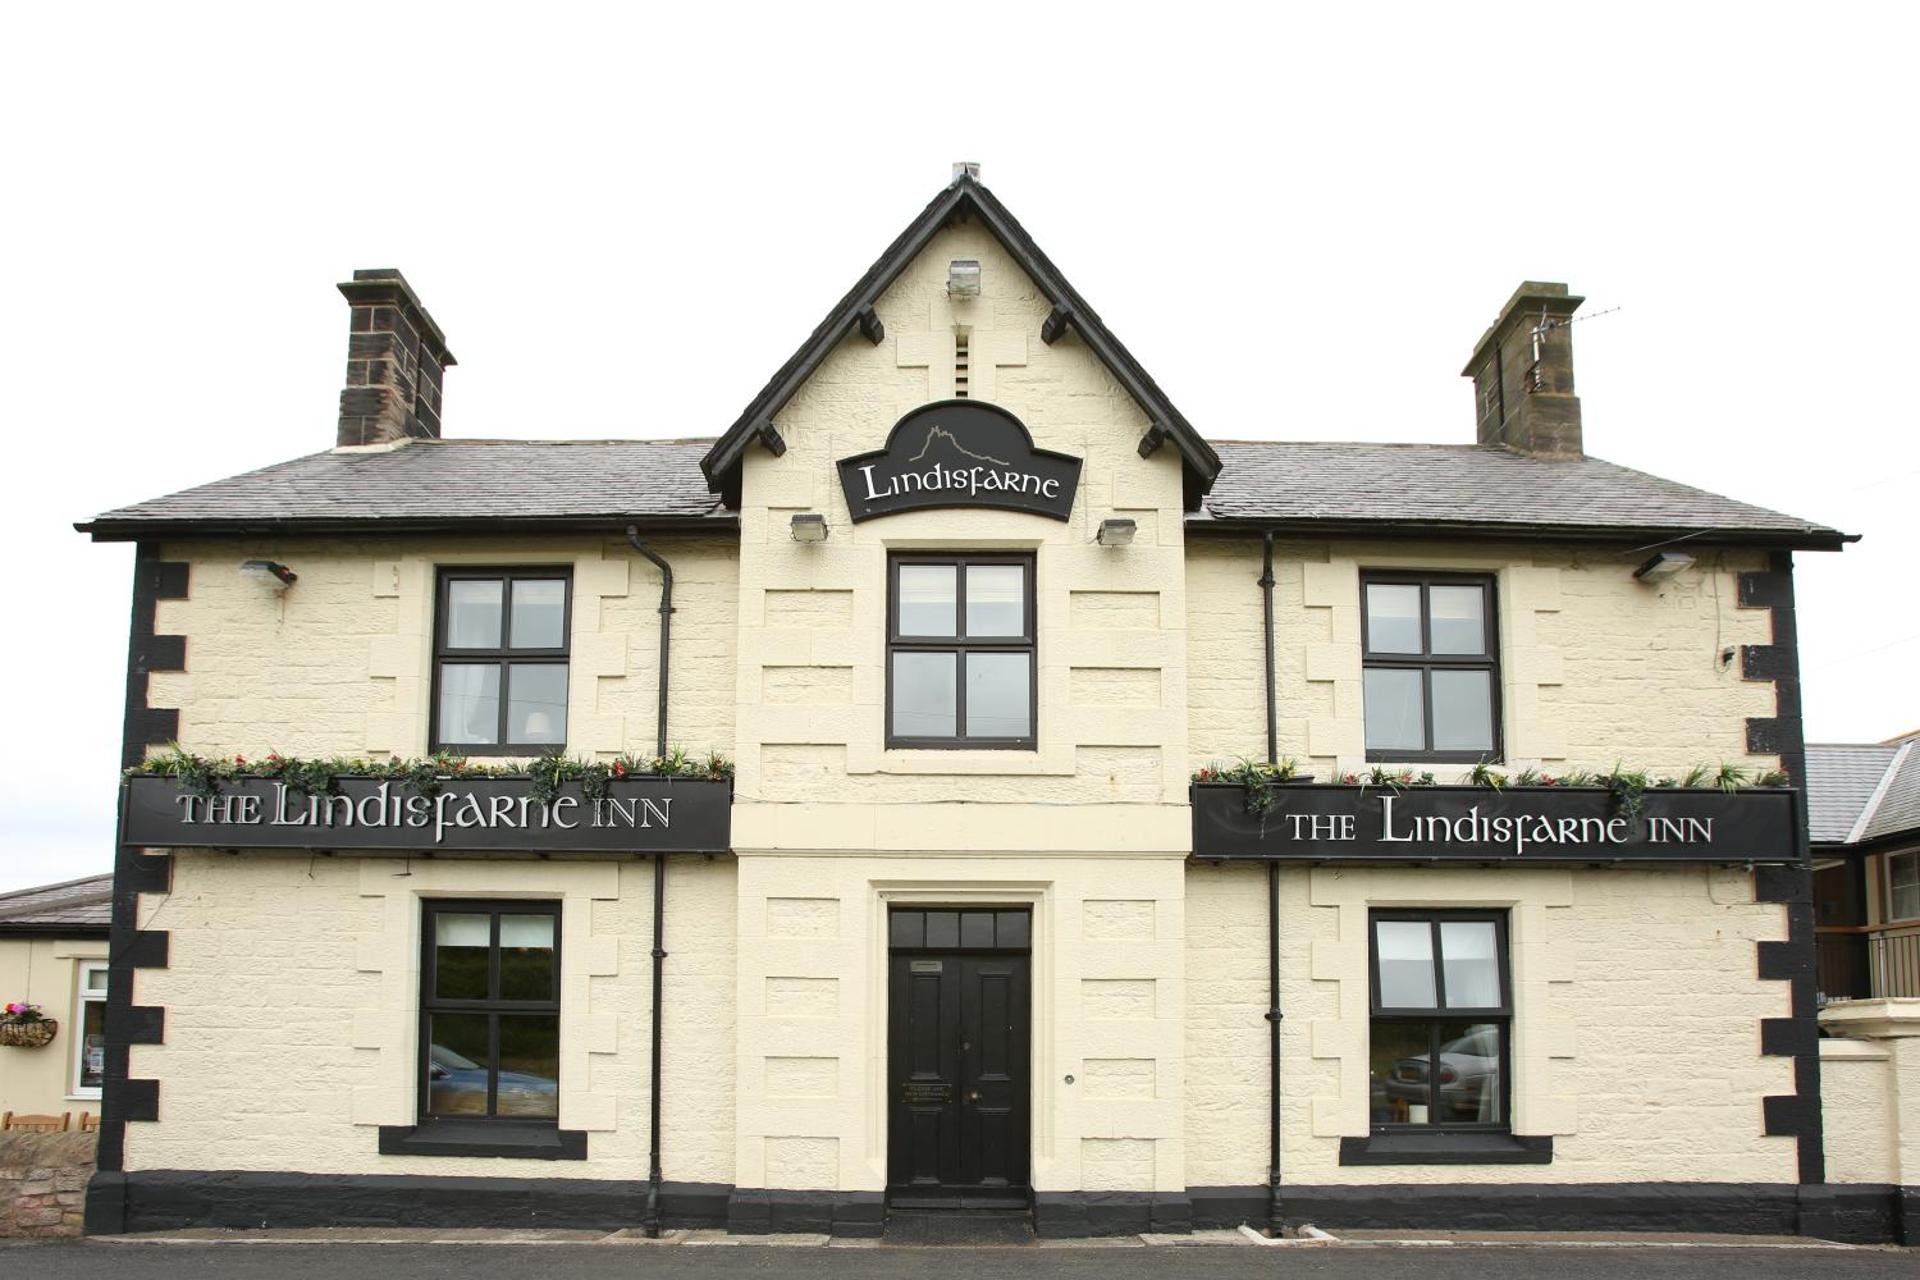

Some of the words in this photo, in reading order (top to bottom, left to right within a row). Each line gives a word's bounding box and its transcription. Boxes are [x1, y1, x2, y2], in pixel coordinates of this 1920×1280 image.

[858, 462, 1060, 501] Lindisfarne
[175, 793, 262, 825] THE
[270, 782, 578, 843] Lindisfarne
[591, 796, 673, 829] INN
[1285, 813, 1357, 841] THE
[1376, 795, 1628, 856] Lindisfarne
[1647, 817, 1715, 844] INN
